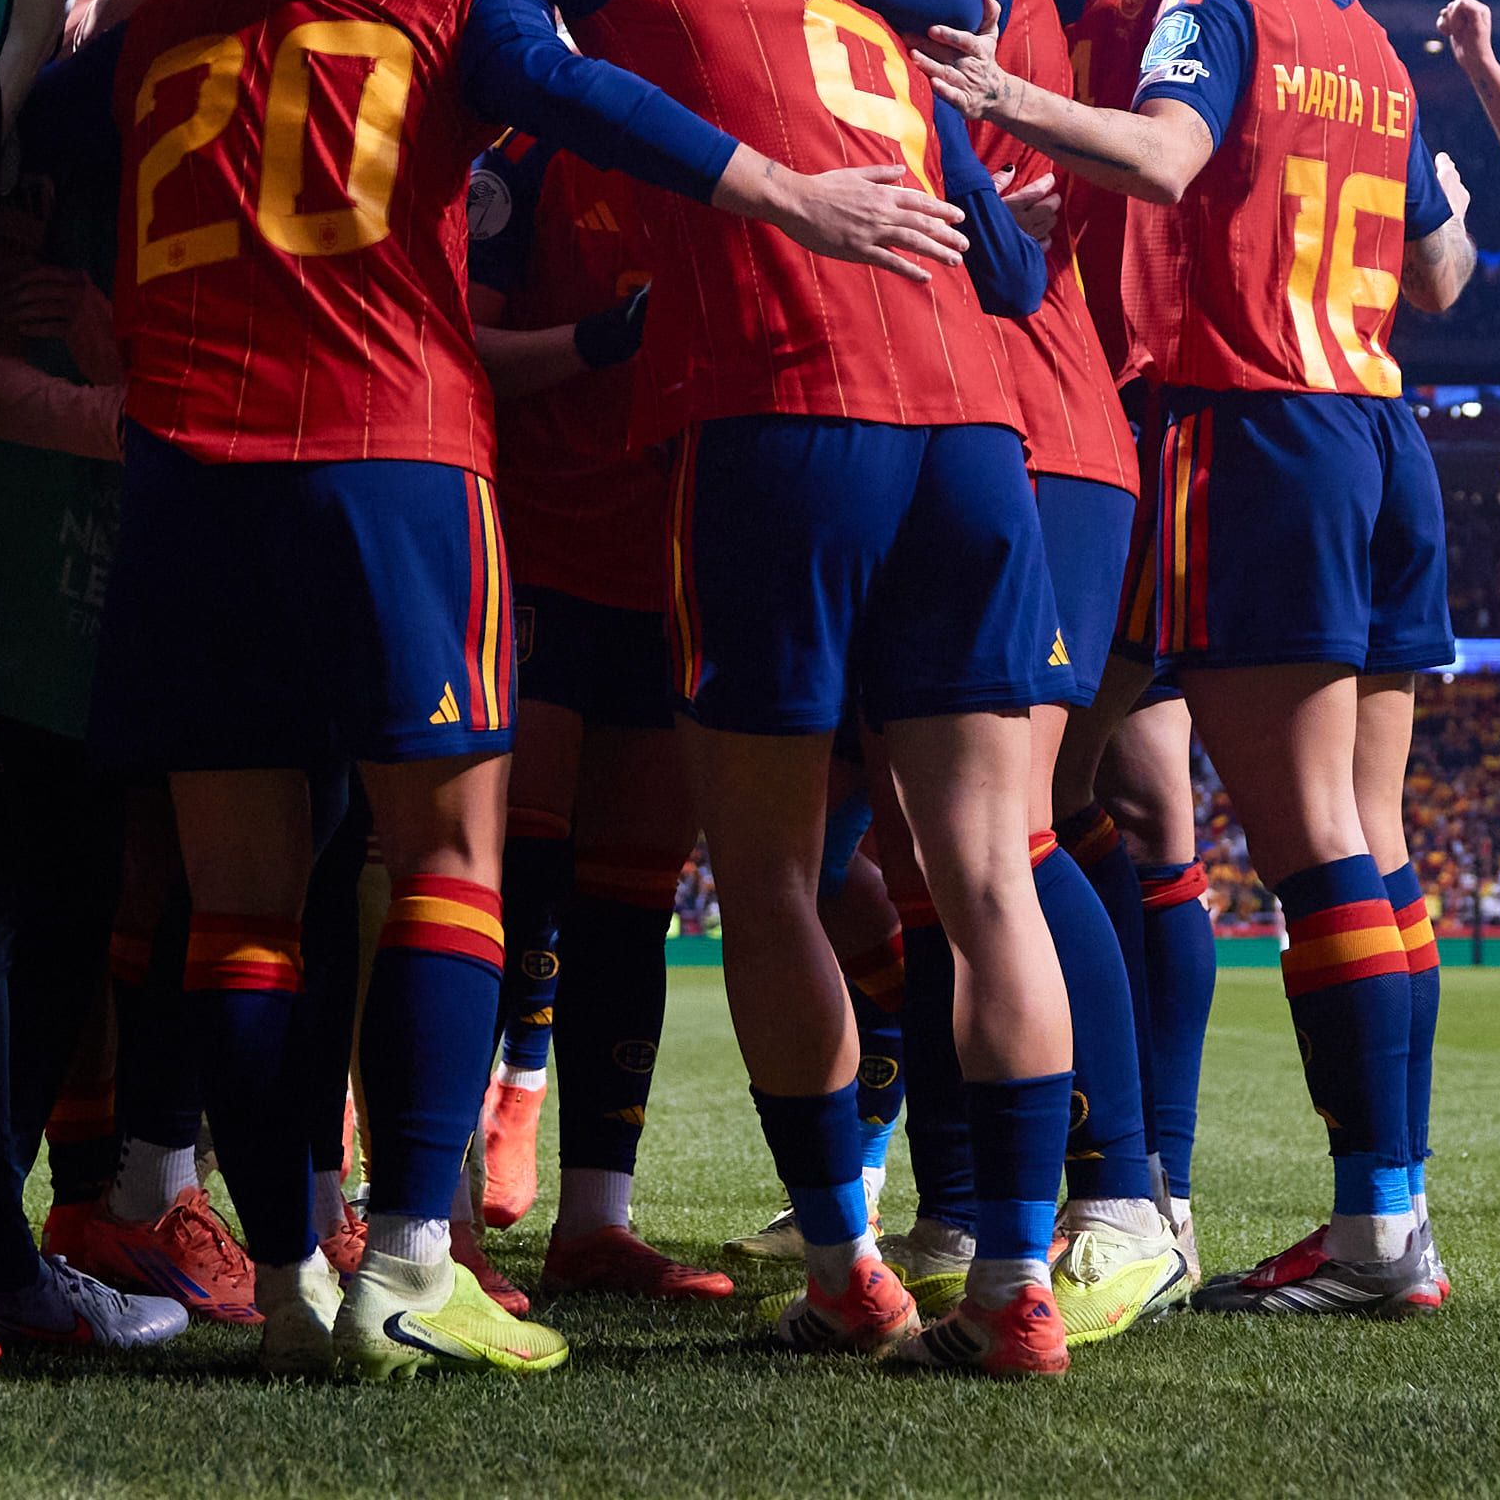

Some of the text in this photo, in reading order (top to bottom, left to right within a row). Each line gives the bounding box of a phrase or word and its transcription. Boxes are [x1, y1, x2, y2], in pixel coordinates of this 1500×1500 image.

[135, 20, 415, 287] 20
[1273, 64, 1364, 127] MARÍA
[1283, 155, 1406, 398] 16
[406, 1319, 433, 1340] MEDINA
